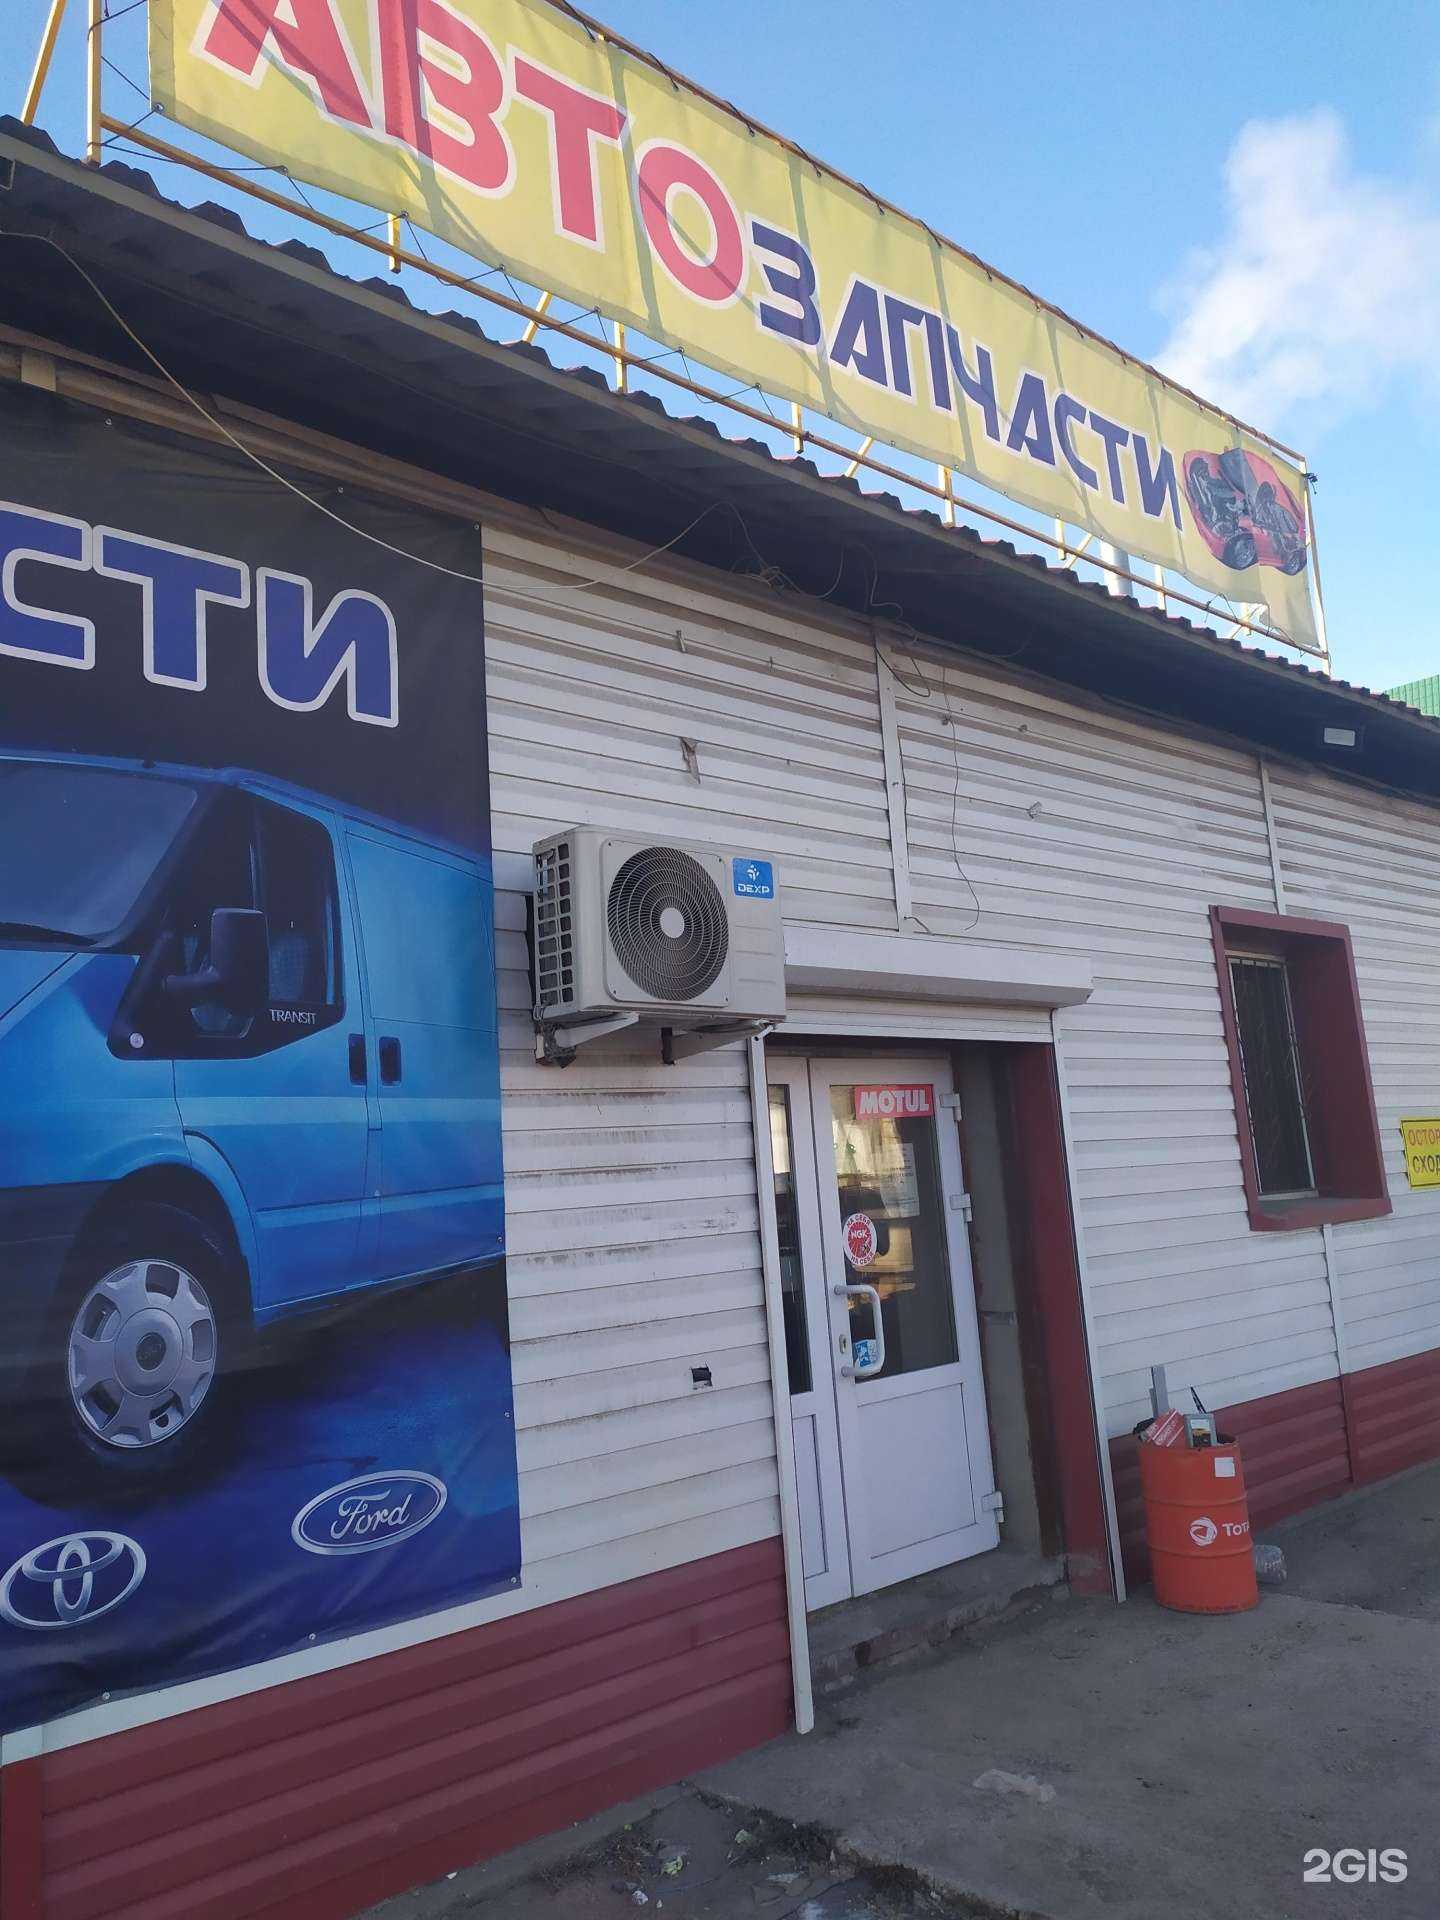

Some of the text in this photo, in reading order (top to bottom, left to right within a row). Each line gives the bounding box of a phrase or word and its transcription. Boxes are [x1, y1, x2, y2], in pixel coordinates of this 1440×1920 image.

[737, 883, 770, 894] DEXP
[269, 1009, 317, 1024] TRANSIT
[860, 1089, 930, 1114] MOTUL
[851, 1229, 869, 1239] NGK
[330, 1488, 412, 1539] Ford
